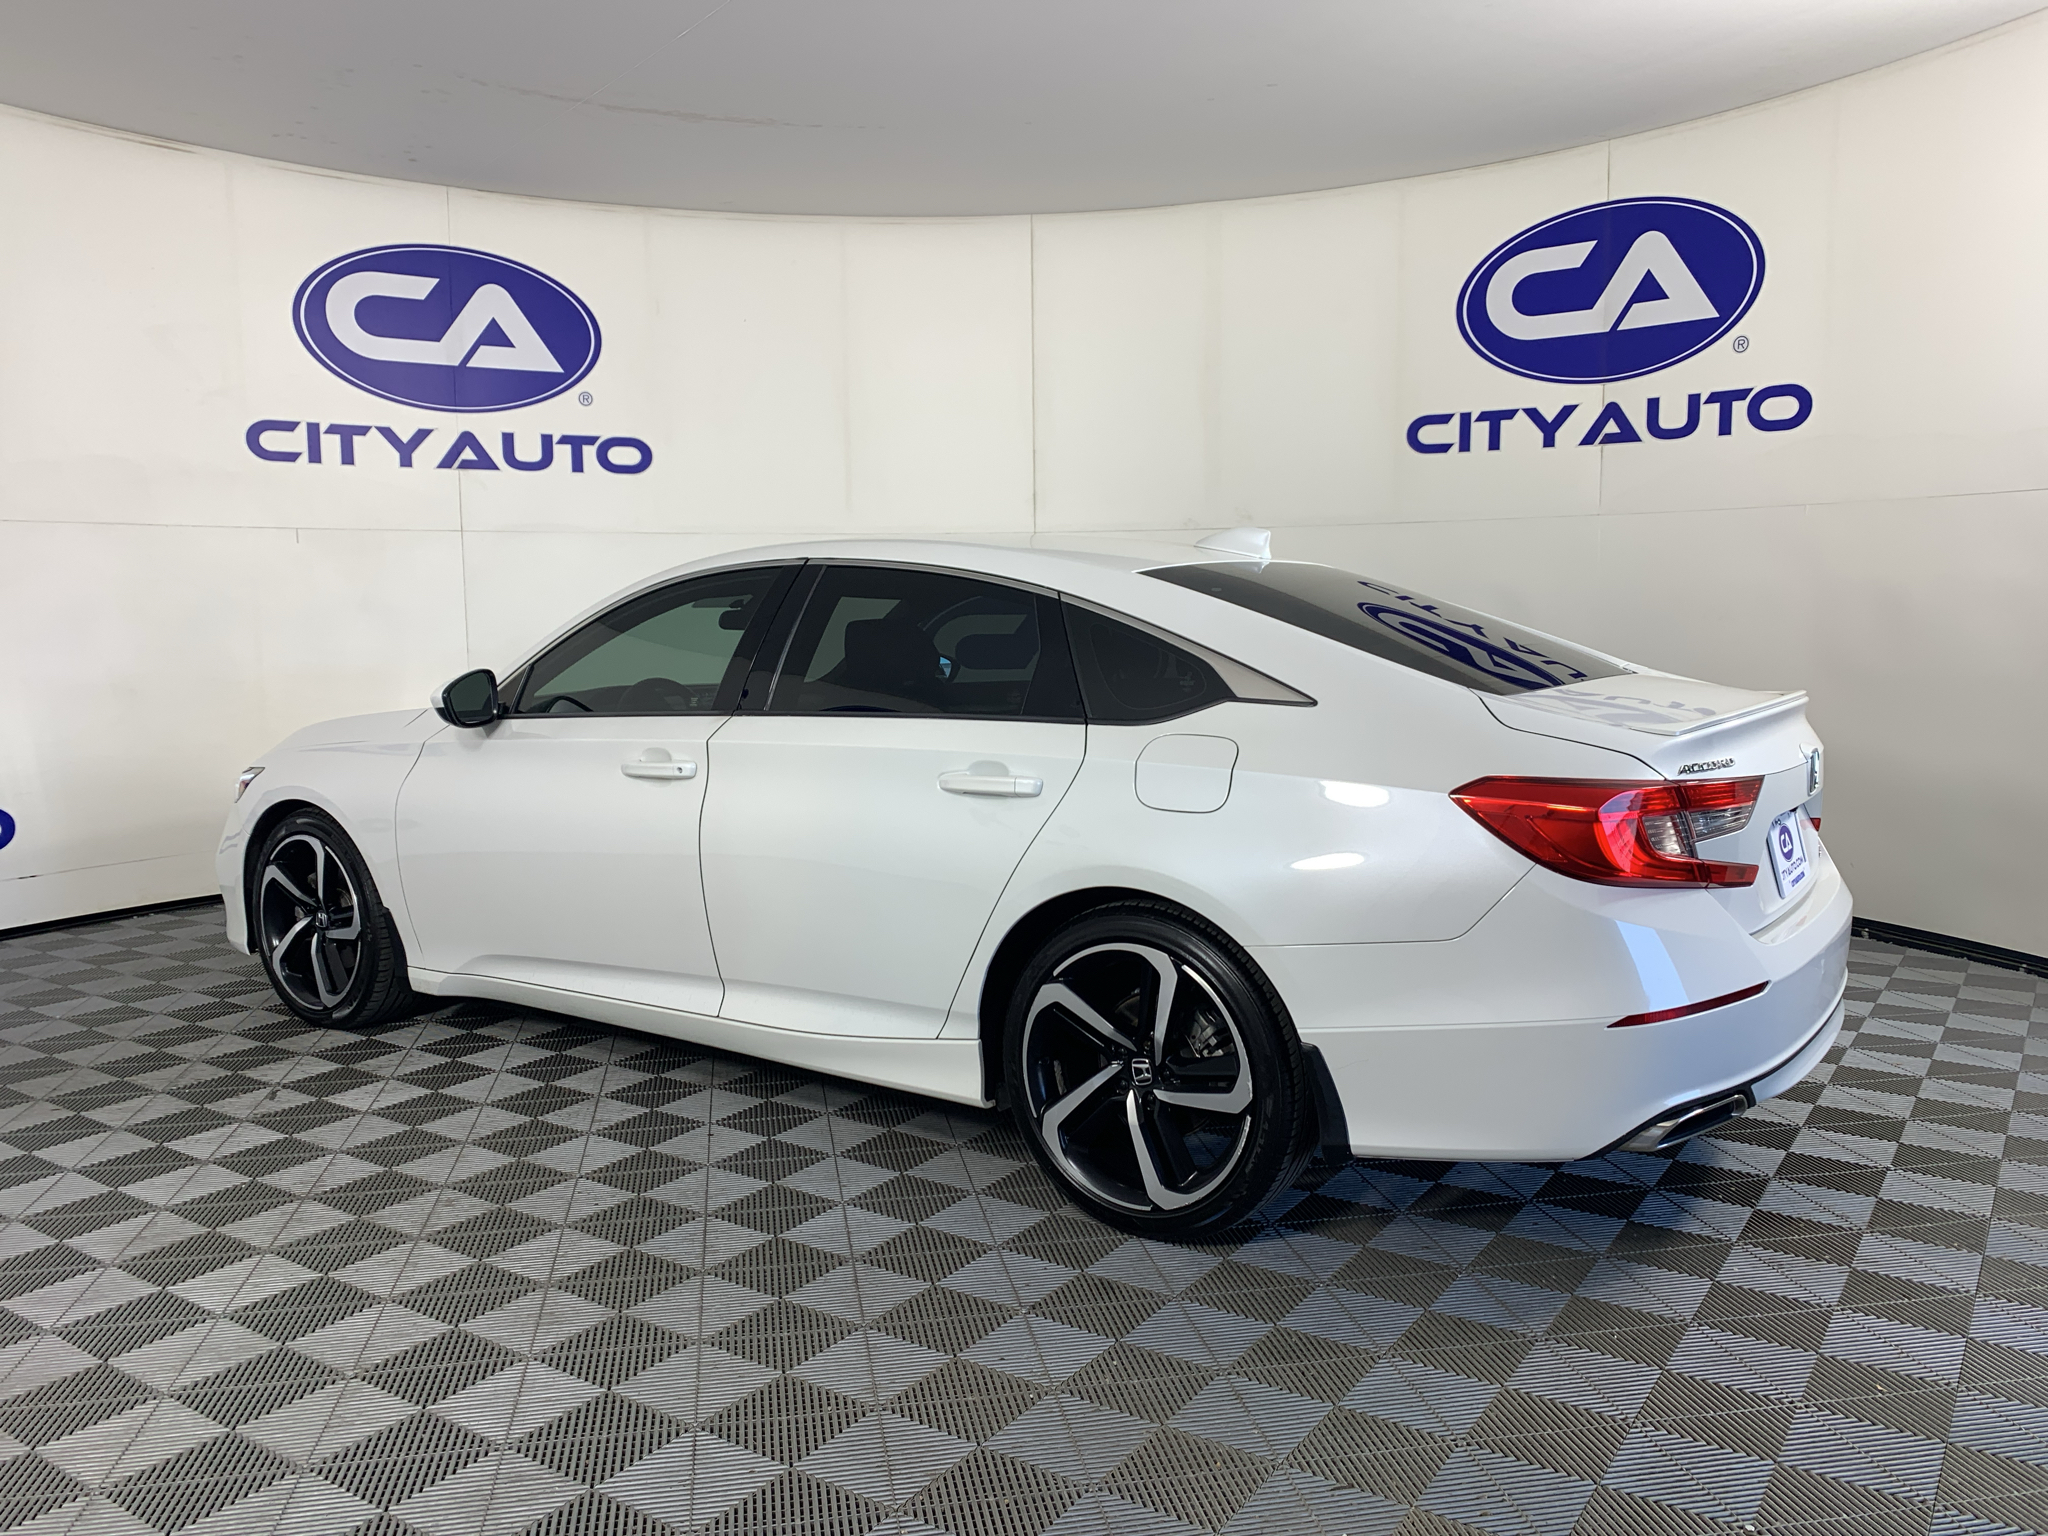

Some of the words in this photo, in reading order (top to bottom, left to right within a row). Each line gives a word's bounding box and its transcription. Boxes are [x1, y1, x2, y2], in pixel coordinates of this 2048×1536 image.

[1486, 230, 1720, 340] CA
[325, 271, 565, 373] CA
[245, 419, 436, 468] CITY
[436, 430, 653, 474] AUTO
[1406, 403, 1579, 454] CITY
[1577, 383, 1813, 446] AUTO
[1678, 757, 1735, 775] ACCORD
